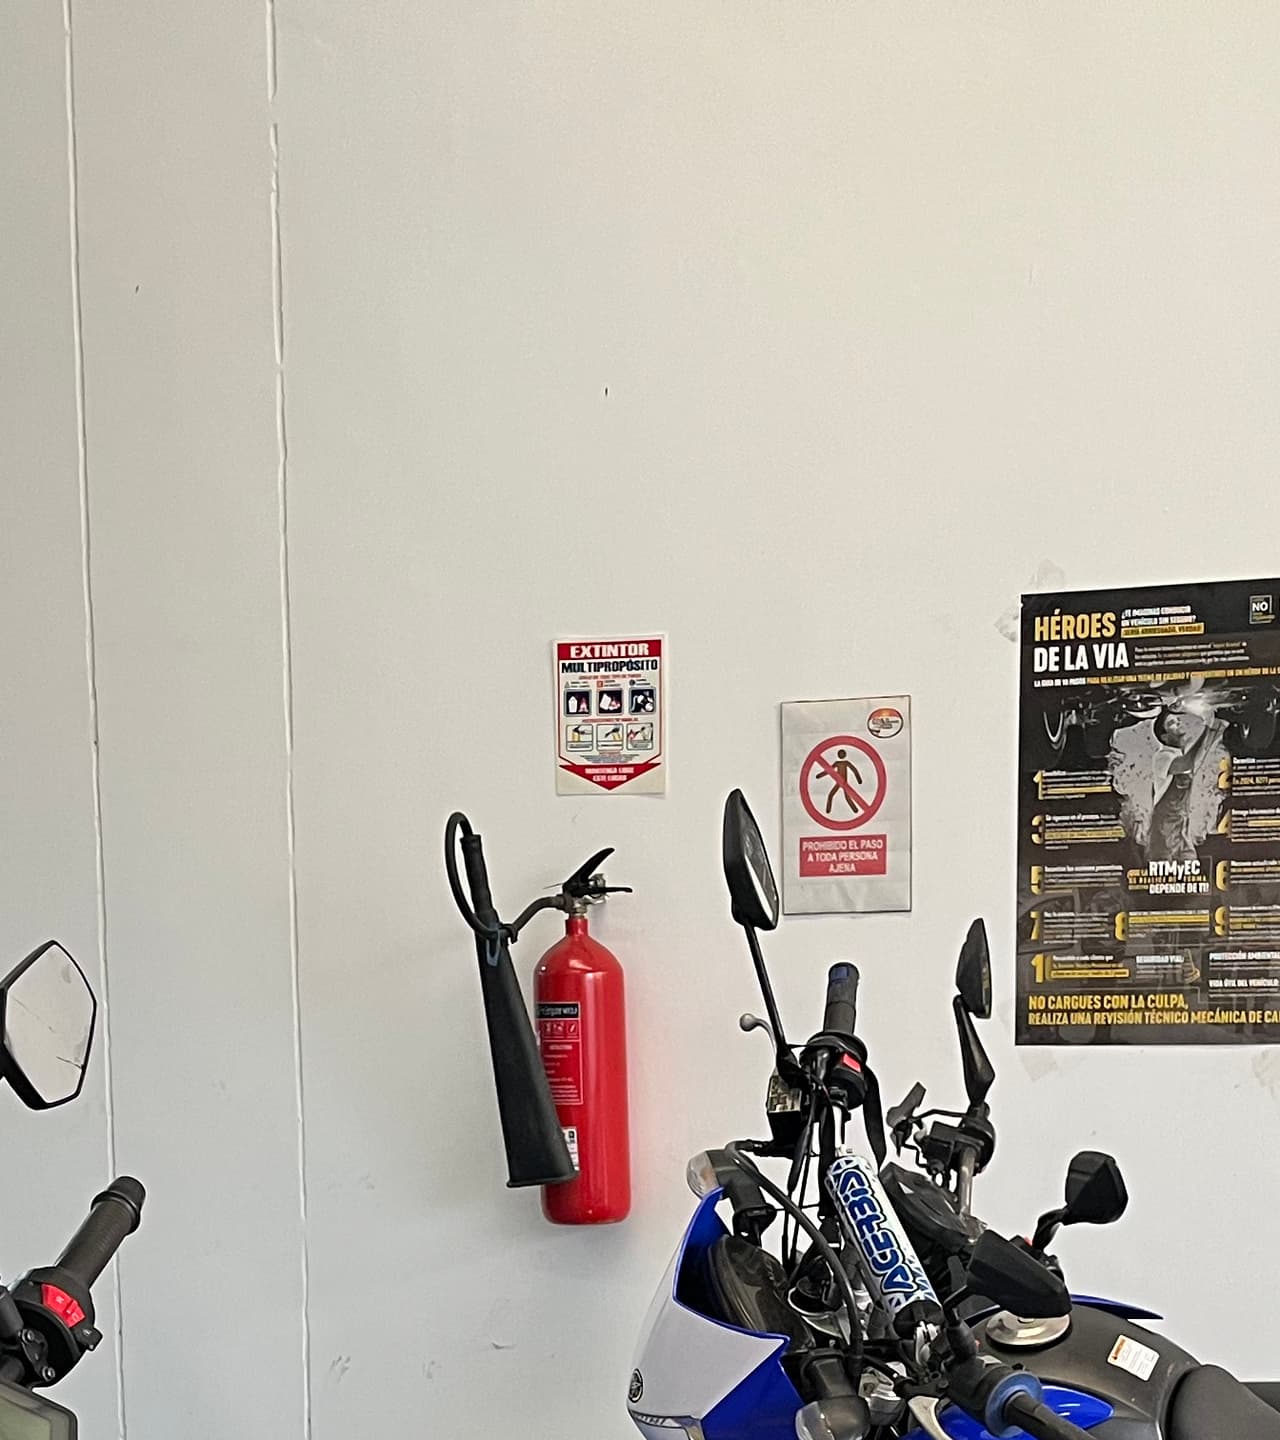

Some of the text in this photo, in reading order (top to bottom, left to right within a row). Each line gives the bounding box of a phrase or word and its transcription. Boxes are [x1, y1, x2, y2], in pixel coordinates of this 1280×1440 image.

[1252, 601, 1269, 612] NO
[1034, 608, 1117, 641] HÉROES
[570, 643, 650, 659] EXTINTOR
[1033, 646, 1060, 673] DE
[1064, 644, 1089, 671] LA
[1092, 642, 1129, 669] VIA
[561, 659, 658, 674] MULTIPROPÓSITO
[802, 839, 883, 851] PROHIBIDO EL PASO
[807, 851, 878, 862] A TODA PERSONA
[828, 863, 856, 873] AJENA
[1149, 883, 1186, 894] DEPENDE
[1186, 883, 1198, 893] DE
[1028, 994, 1189, 1010] NO CARGUES CON LA CULPA,
[1028, 1012, 1068, 1025] REALIZA
[1071, 1012, 1092, 1024] UNA
[1094, 1009, 1143, 1024] REVISIÓN
[1144, 1009, 1189, 1024] TÉCNICO
[1190, 1007, 1247, 1023] MECÁNICA
[1248, 1010, 1263, 1023] DE
